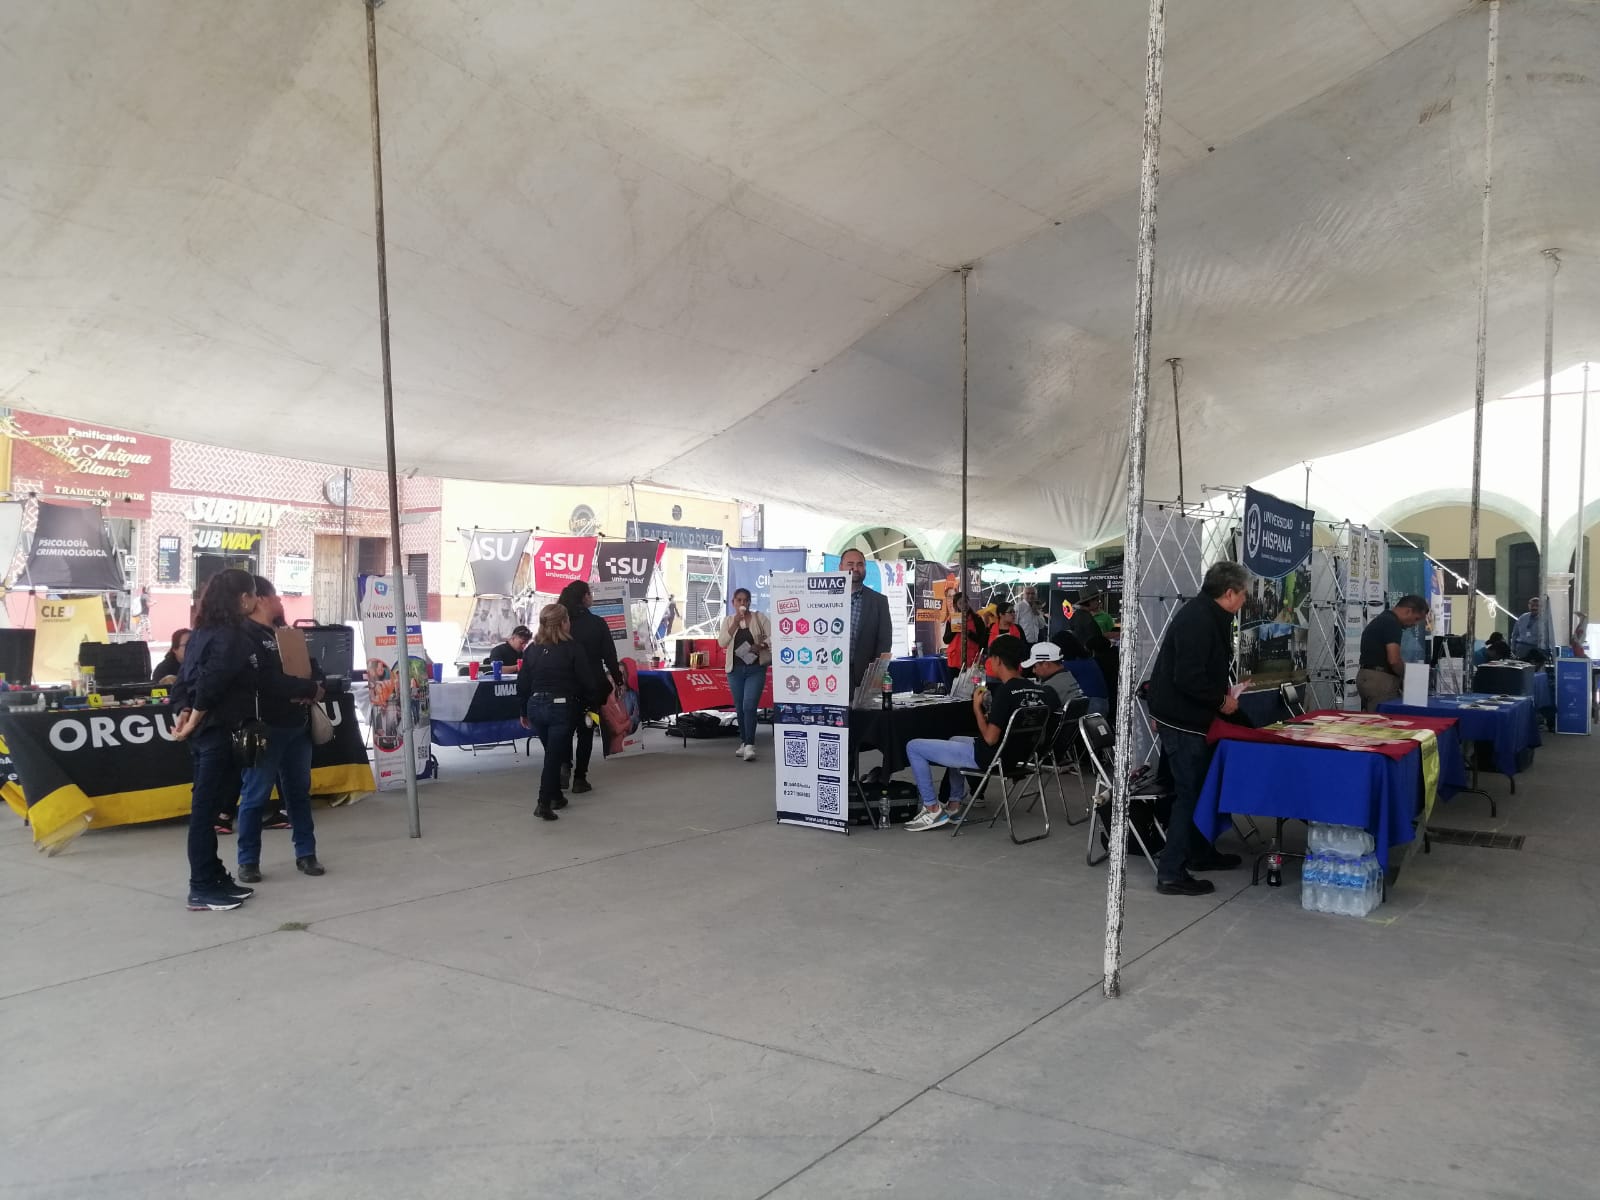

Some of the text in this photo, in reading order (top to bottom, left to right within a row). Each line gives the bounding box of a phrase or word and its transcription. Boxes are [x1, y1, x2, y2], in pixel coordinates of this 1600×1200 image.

[67, 427, 137, 444] Panificadora
[82, 443, 152, 467] Antigua
[71, 456, 131, 478] Blanca
[185, 496, 290, 528] SUBWAY
[1263, 511, 1294, 530] UNIVERSIDAD
[38, 538, 88, 548] PSICOLOGÍA
[191, 530, 262, 550] SUBWAY
[1262, 530, 1292, 553] HISPANA
[35, 548, 108, 558] CRIMINOLÓGICA
[809, 578, 845, 589] UMAG
